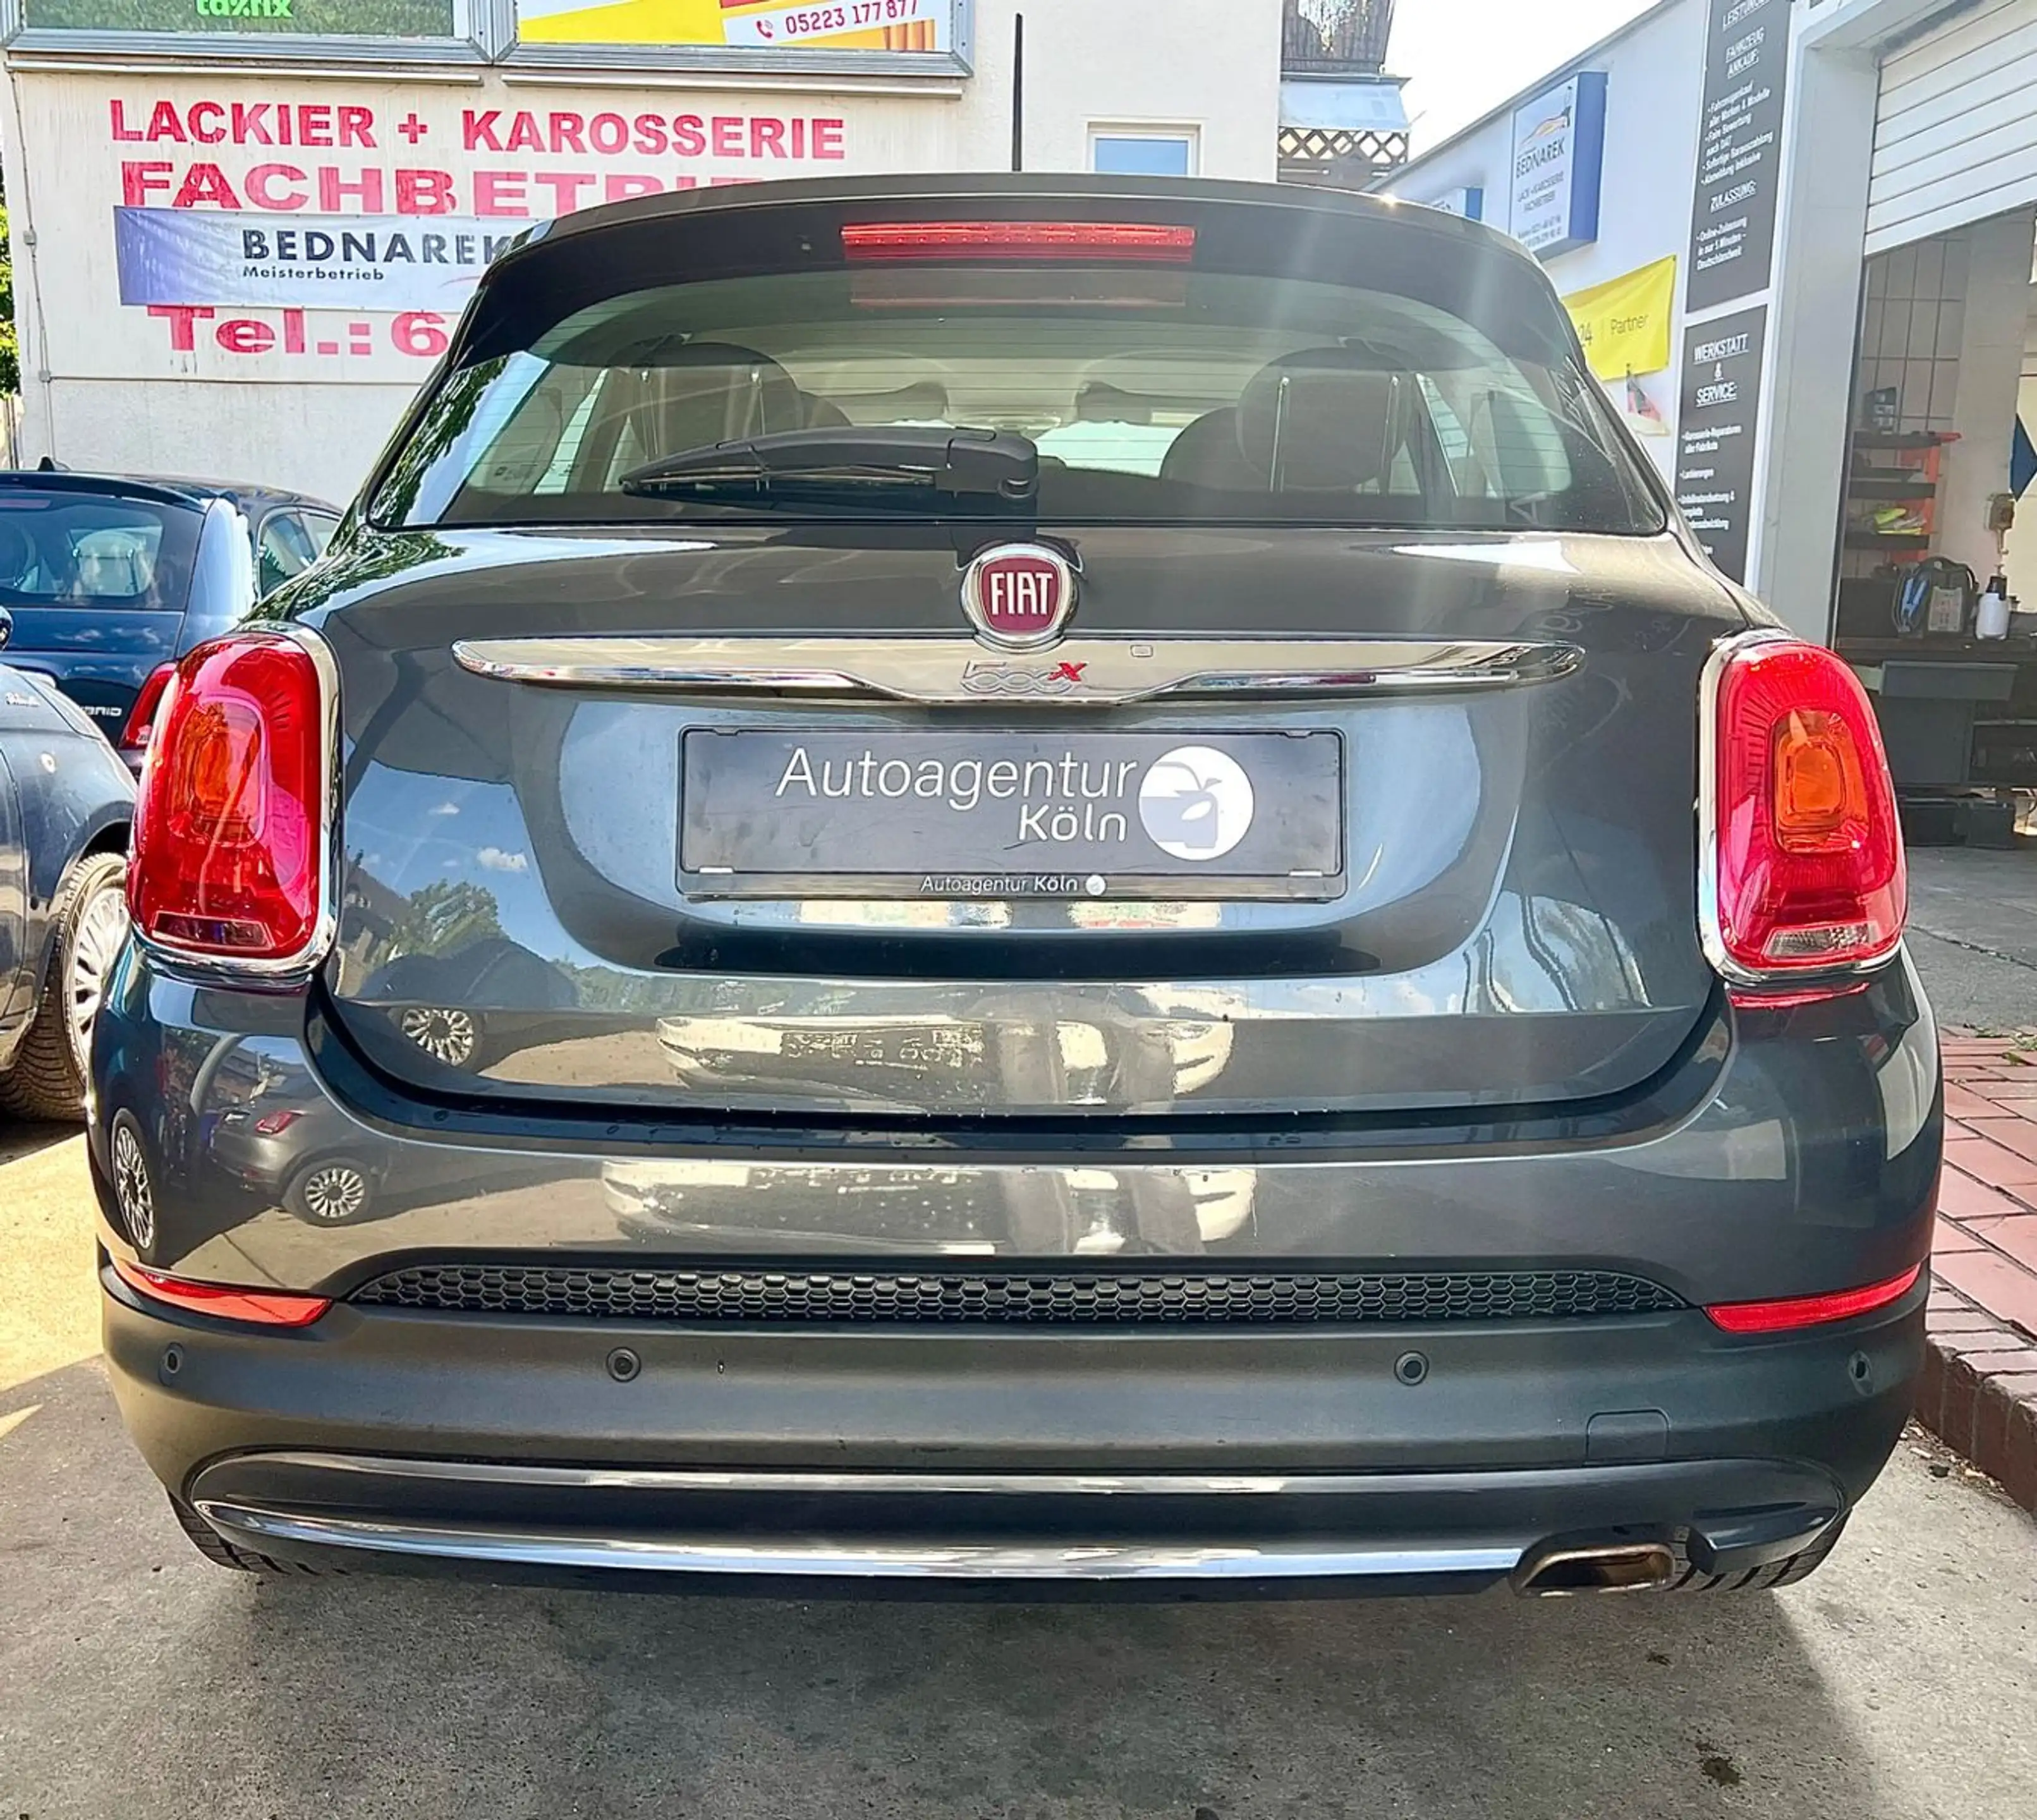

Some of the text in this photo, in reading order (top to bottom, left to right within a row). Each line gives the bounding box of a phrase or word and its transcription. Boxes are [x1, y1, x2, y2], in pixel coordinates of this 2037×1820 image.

[786, 8, 845, 34] 05223
[109, 99, 845, 160] LACKIER + KAROSSERIE
[243, 266, 384, 281] Meisterbetrieb
[1610, 314, 1649, 335] Partner
[1694, 333, 1749, 363] WERKSTATT
[1713, 362, 1722, 378] &
[990, 571, 1054, 616] FIAT
[775, 747, 1138, 811] Autoagentur
[1017, 803, 1127, 842] Köln
[920, 875, 1078, 895] Autoagentur Köln
